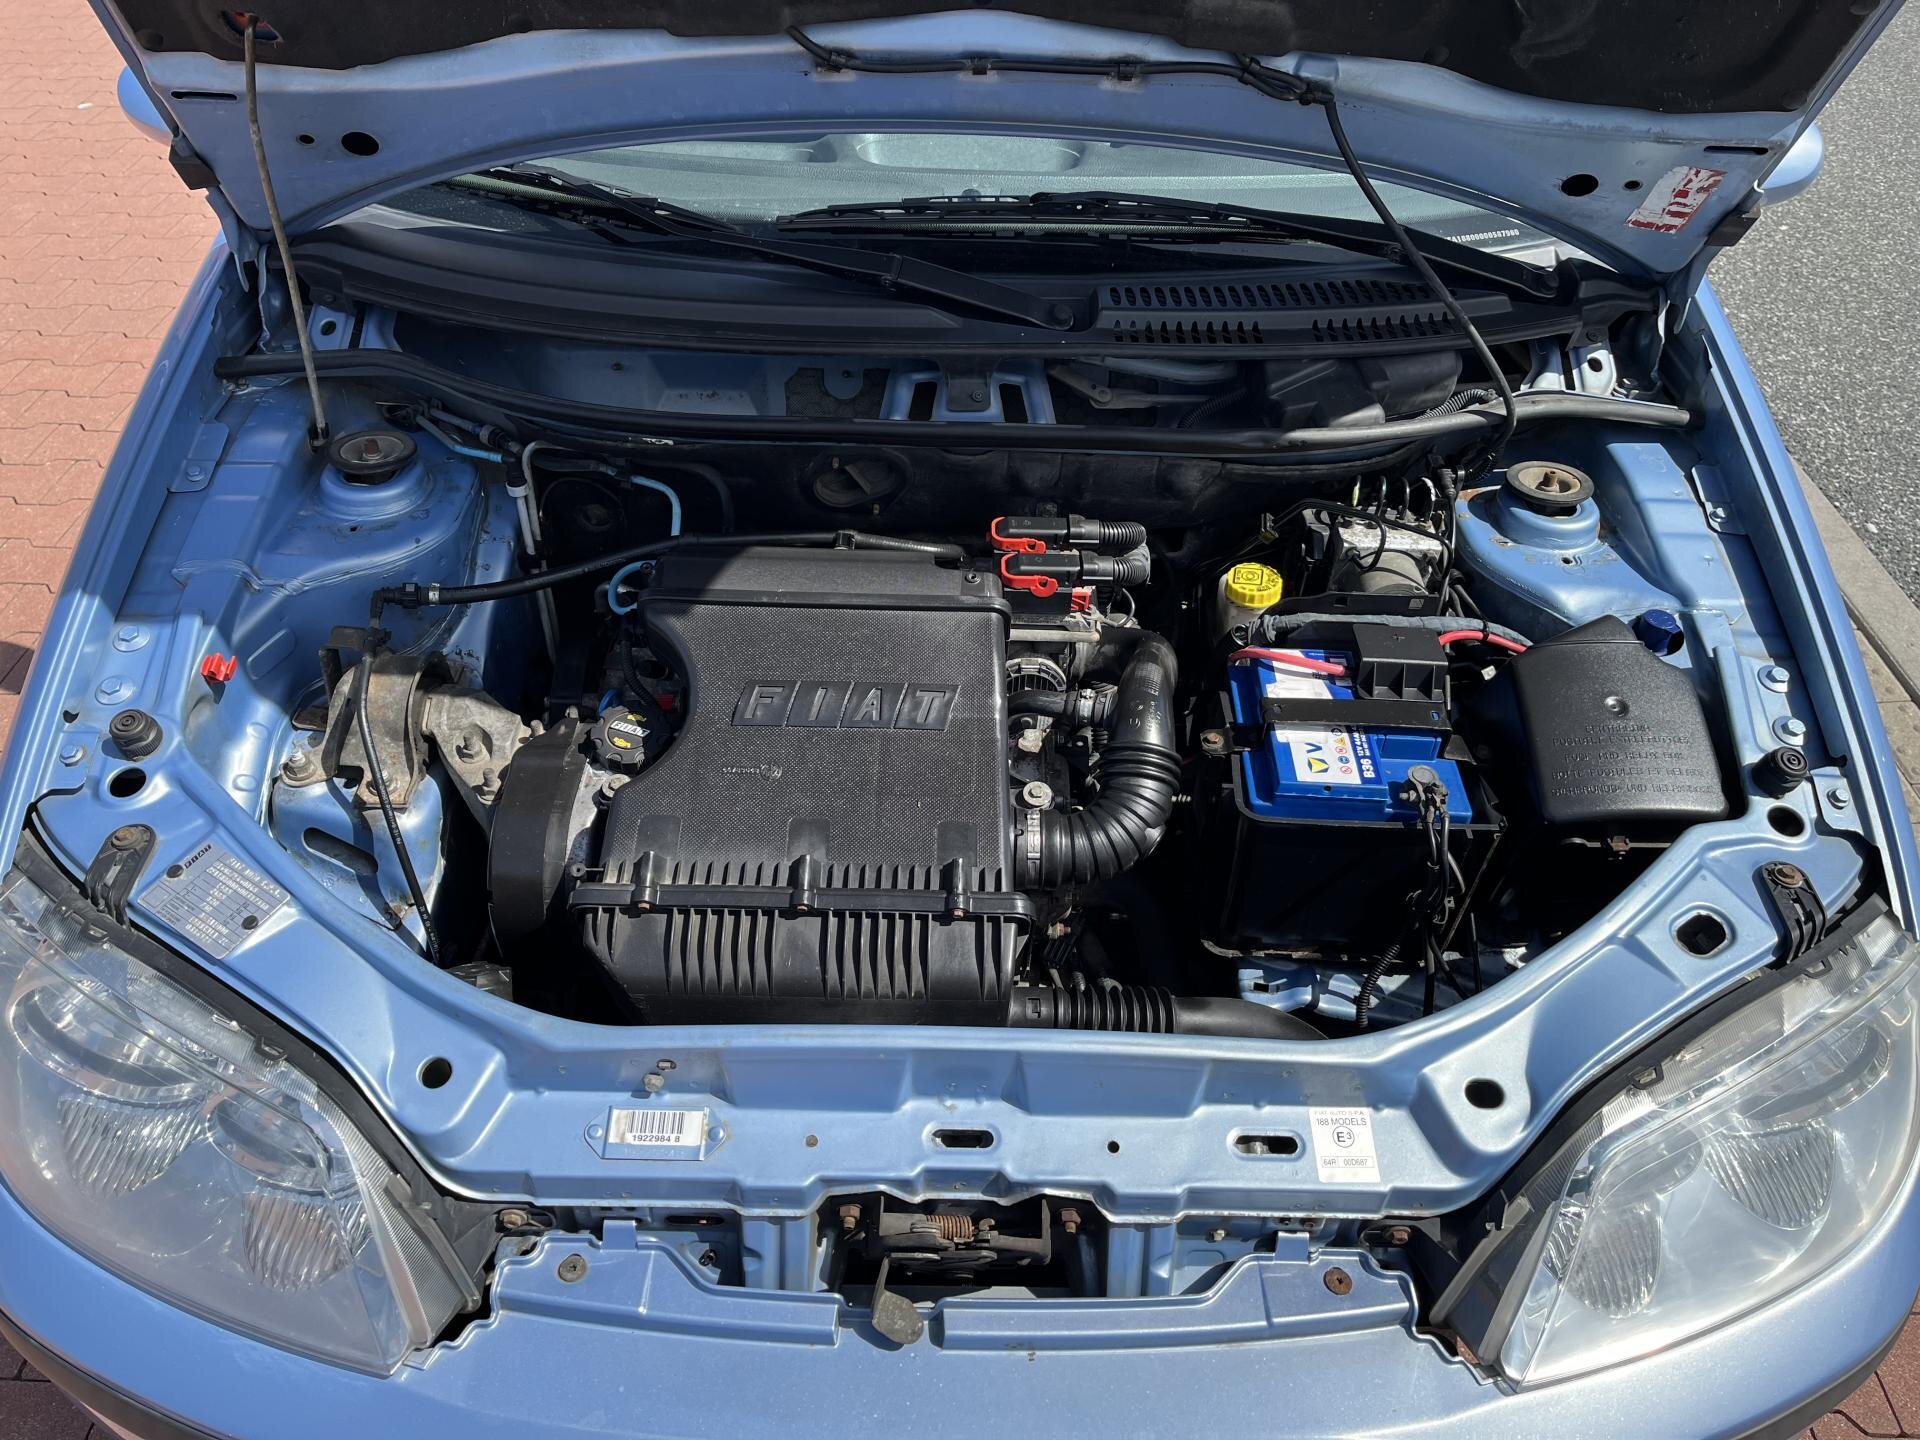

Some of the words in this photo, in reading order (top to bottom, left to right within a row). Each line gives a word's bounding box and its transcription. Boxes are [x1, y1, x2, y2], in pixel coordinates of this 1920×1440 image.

[743, 684, 948, 725] FIAT
[611, 721, 650, 737] FIAT
[1360, 758, 1376, 778] B36
[1316, 1118, 1330, 1126] 188
[1331, 1117, 1367, 1126] MODELS
[632, 1134, 671, 1142] 1922984
